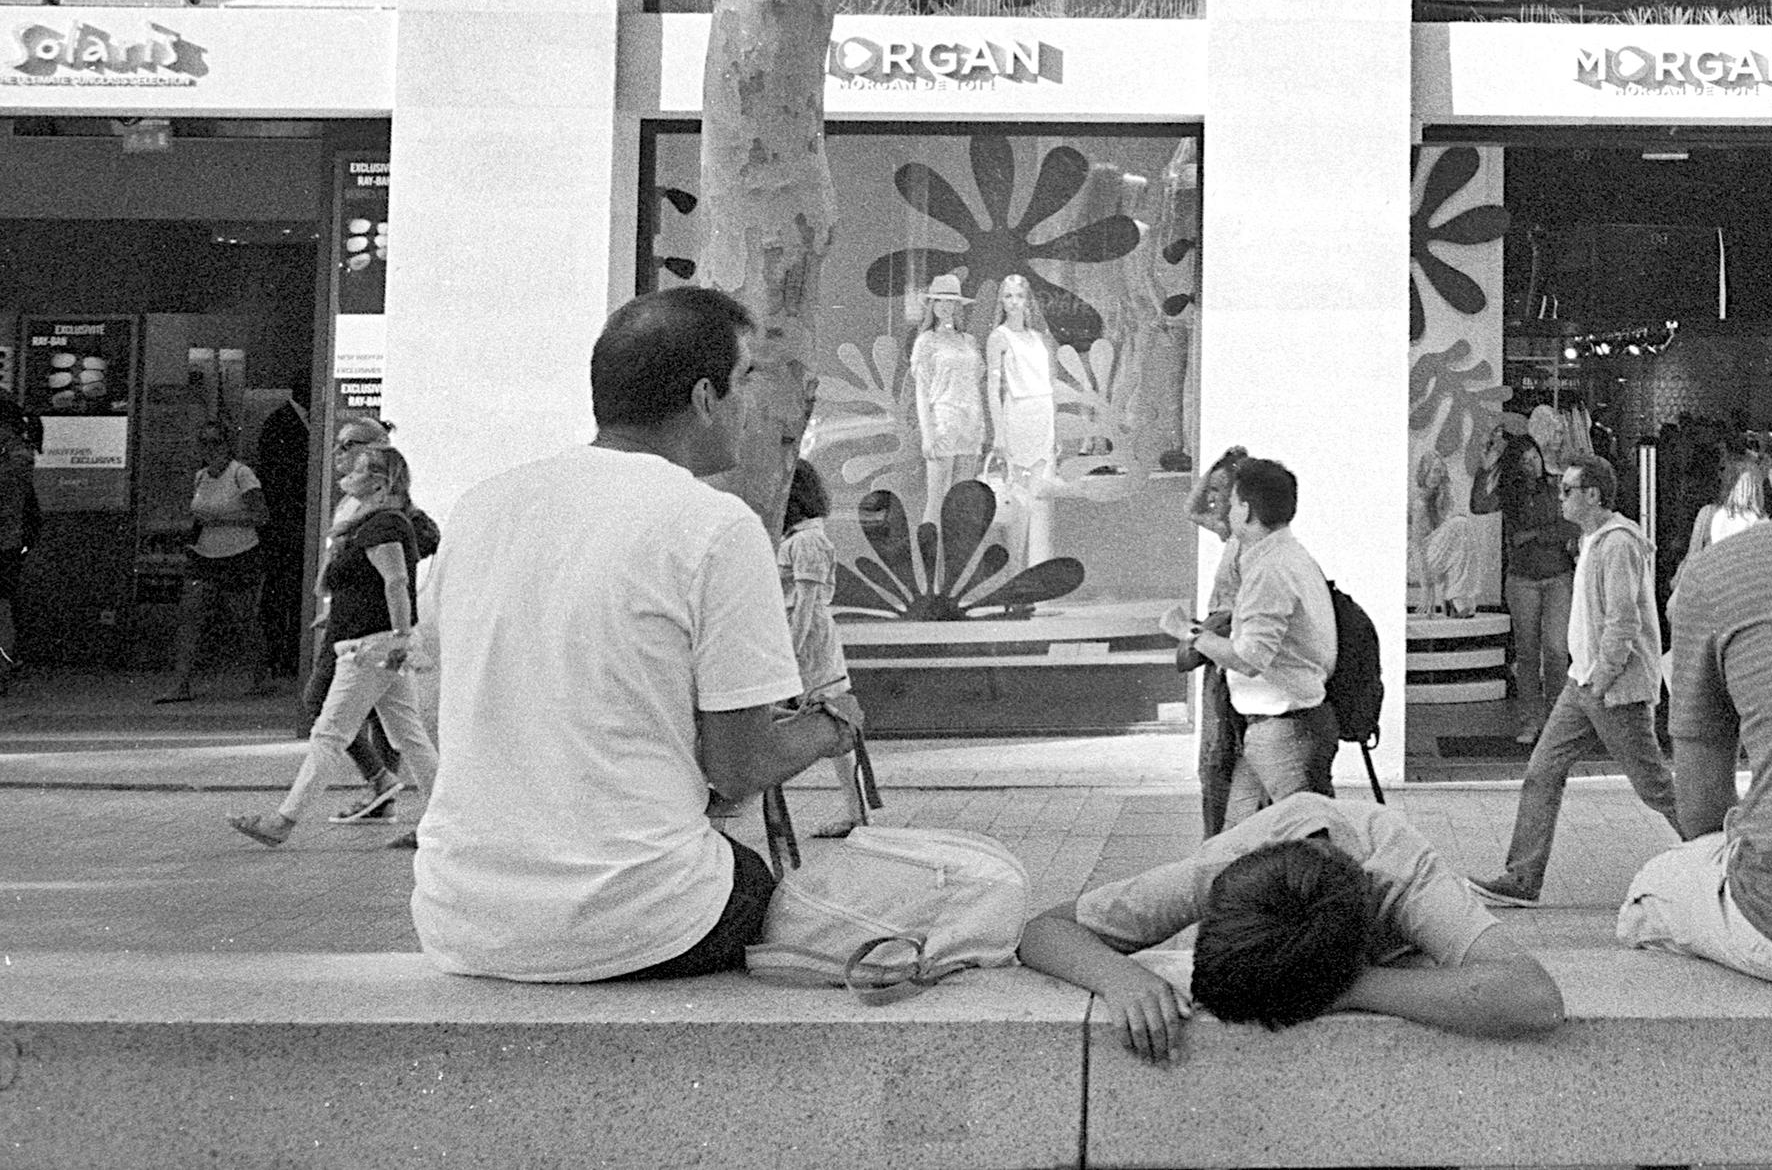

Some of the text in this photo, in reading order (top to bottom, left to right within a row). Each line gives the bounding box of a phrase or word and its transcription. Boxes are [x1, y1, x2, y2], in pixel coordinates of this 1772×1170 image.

[4, 19, 179, 68] Solaris
[824, 36, 1041, 76] ORGAN
[840, 79, 916, 91] MORGAN
[924, 79, 948, 91] DE
